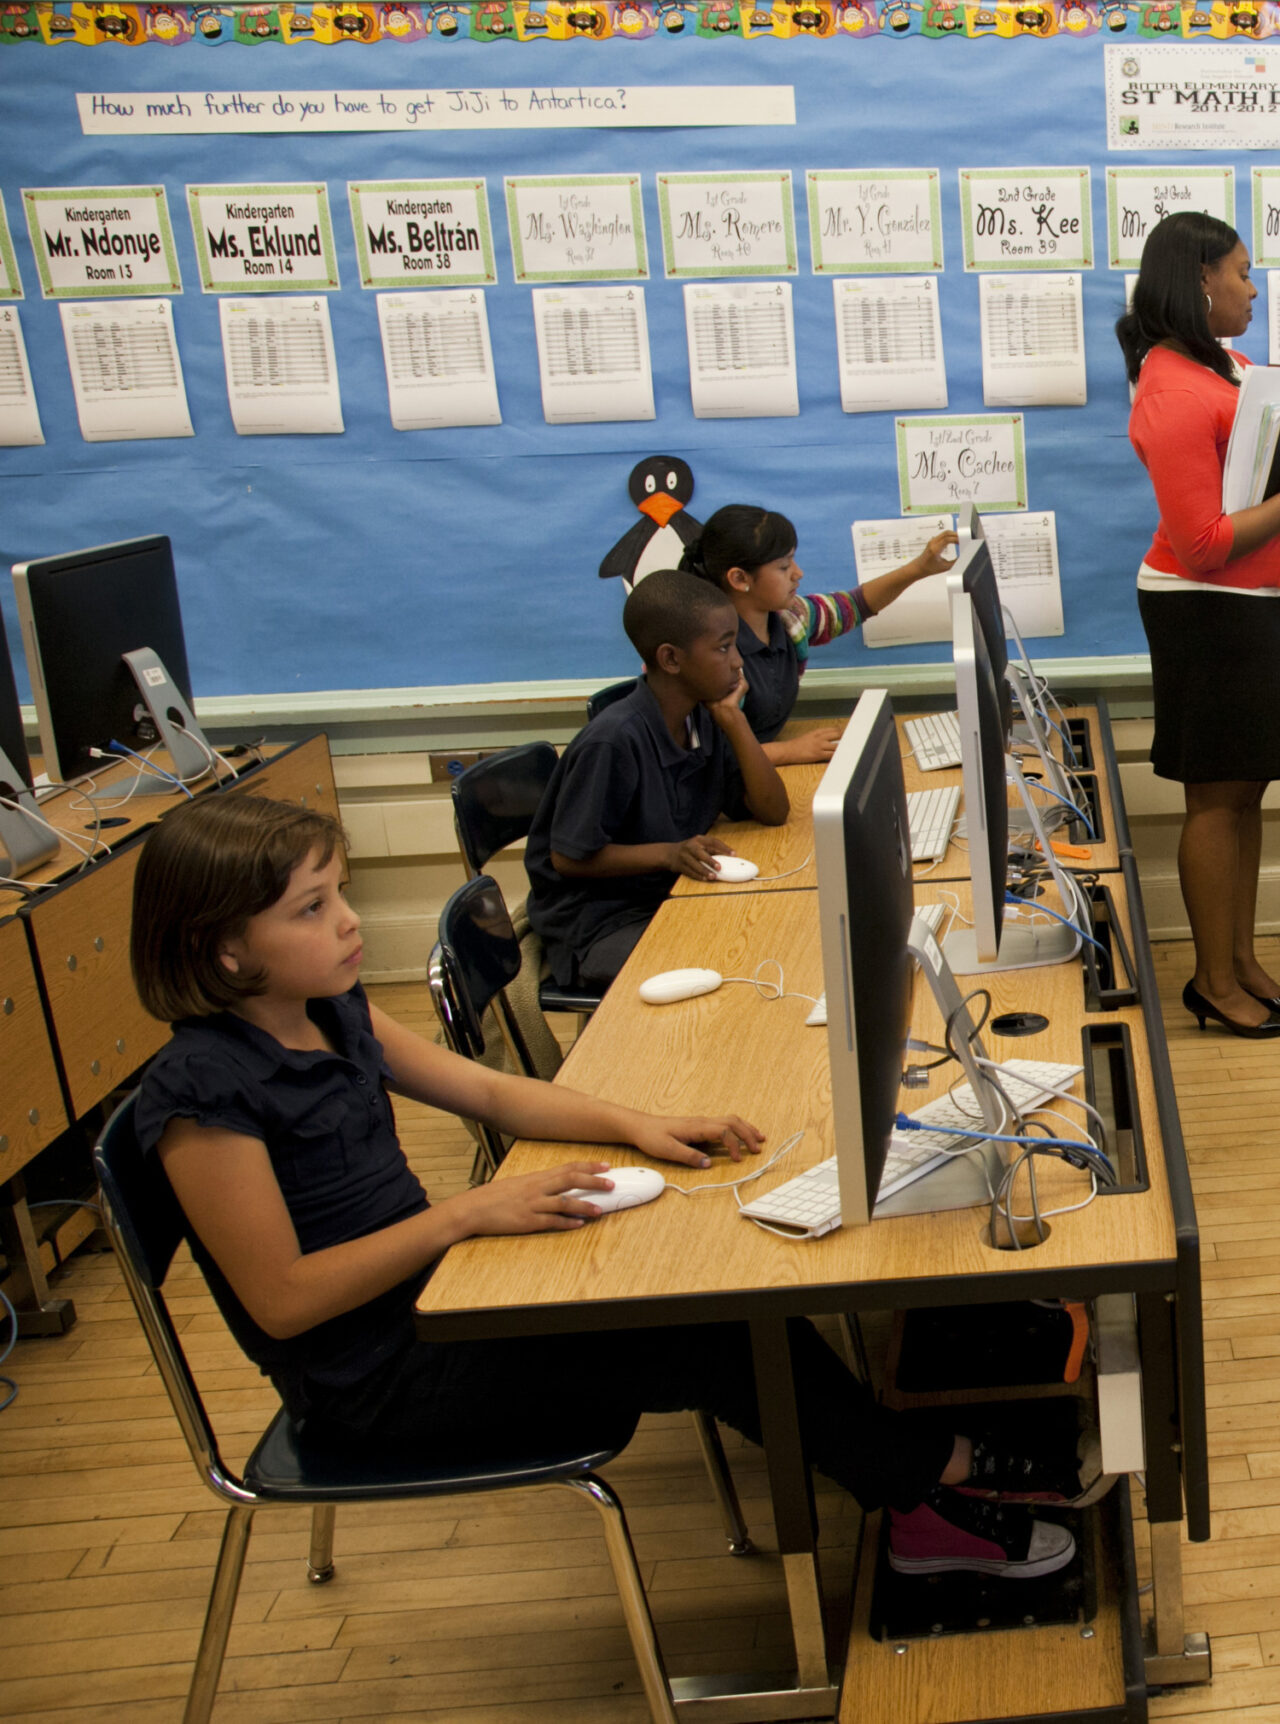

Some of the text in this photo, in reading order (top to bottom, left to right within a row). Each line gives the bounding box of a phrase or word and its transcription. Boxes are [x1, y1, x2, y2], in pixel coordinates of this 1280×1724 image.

[1128, 82, 1179, 91] RITTER
[1184, 81, 1278, 91] ELEMENTARY
[92, 89, 627, 124] How much further do you have to get JiJi to Antartica?
[1121, 91, 1161, 105] ST
[1175, 90, 1259, 105] MATH
[1191, 104, 1278, 113] 2011-2012
[997, 186, 1056, 203] 2nd Grade
[1153, 185, 1192, 200] 2nd Grade
[64, 207, 131, 225] Kindergarten
[225, 203, 295, 223] Kindergarten
[386, 199, 453, 219] Kindergarten
[525, 211, 632, 245] Ms. Washington
[675, 207, 783, 242] Ms. Romero
[822, 203, 932, 237] Mr. Y. González
[976, 203, 1080, 238] Ms. Kee
[44, 226, 161, 263] Mr. Ndonye
[207, 224, 322, 259] Ms. Eklund
[367, 220, 480, 254] Ms. Beltrán
[1000, 239, 1058, 255] Room 39
[243, 258, 294, 275] Room 14
[402, 253, 451, 271] Room 38
[86, 264, 133, 281] Room 13
[965, 429, 992, 445] Grade
[911, 447, 1015, 482] Ms. Cacheo
